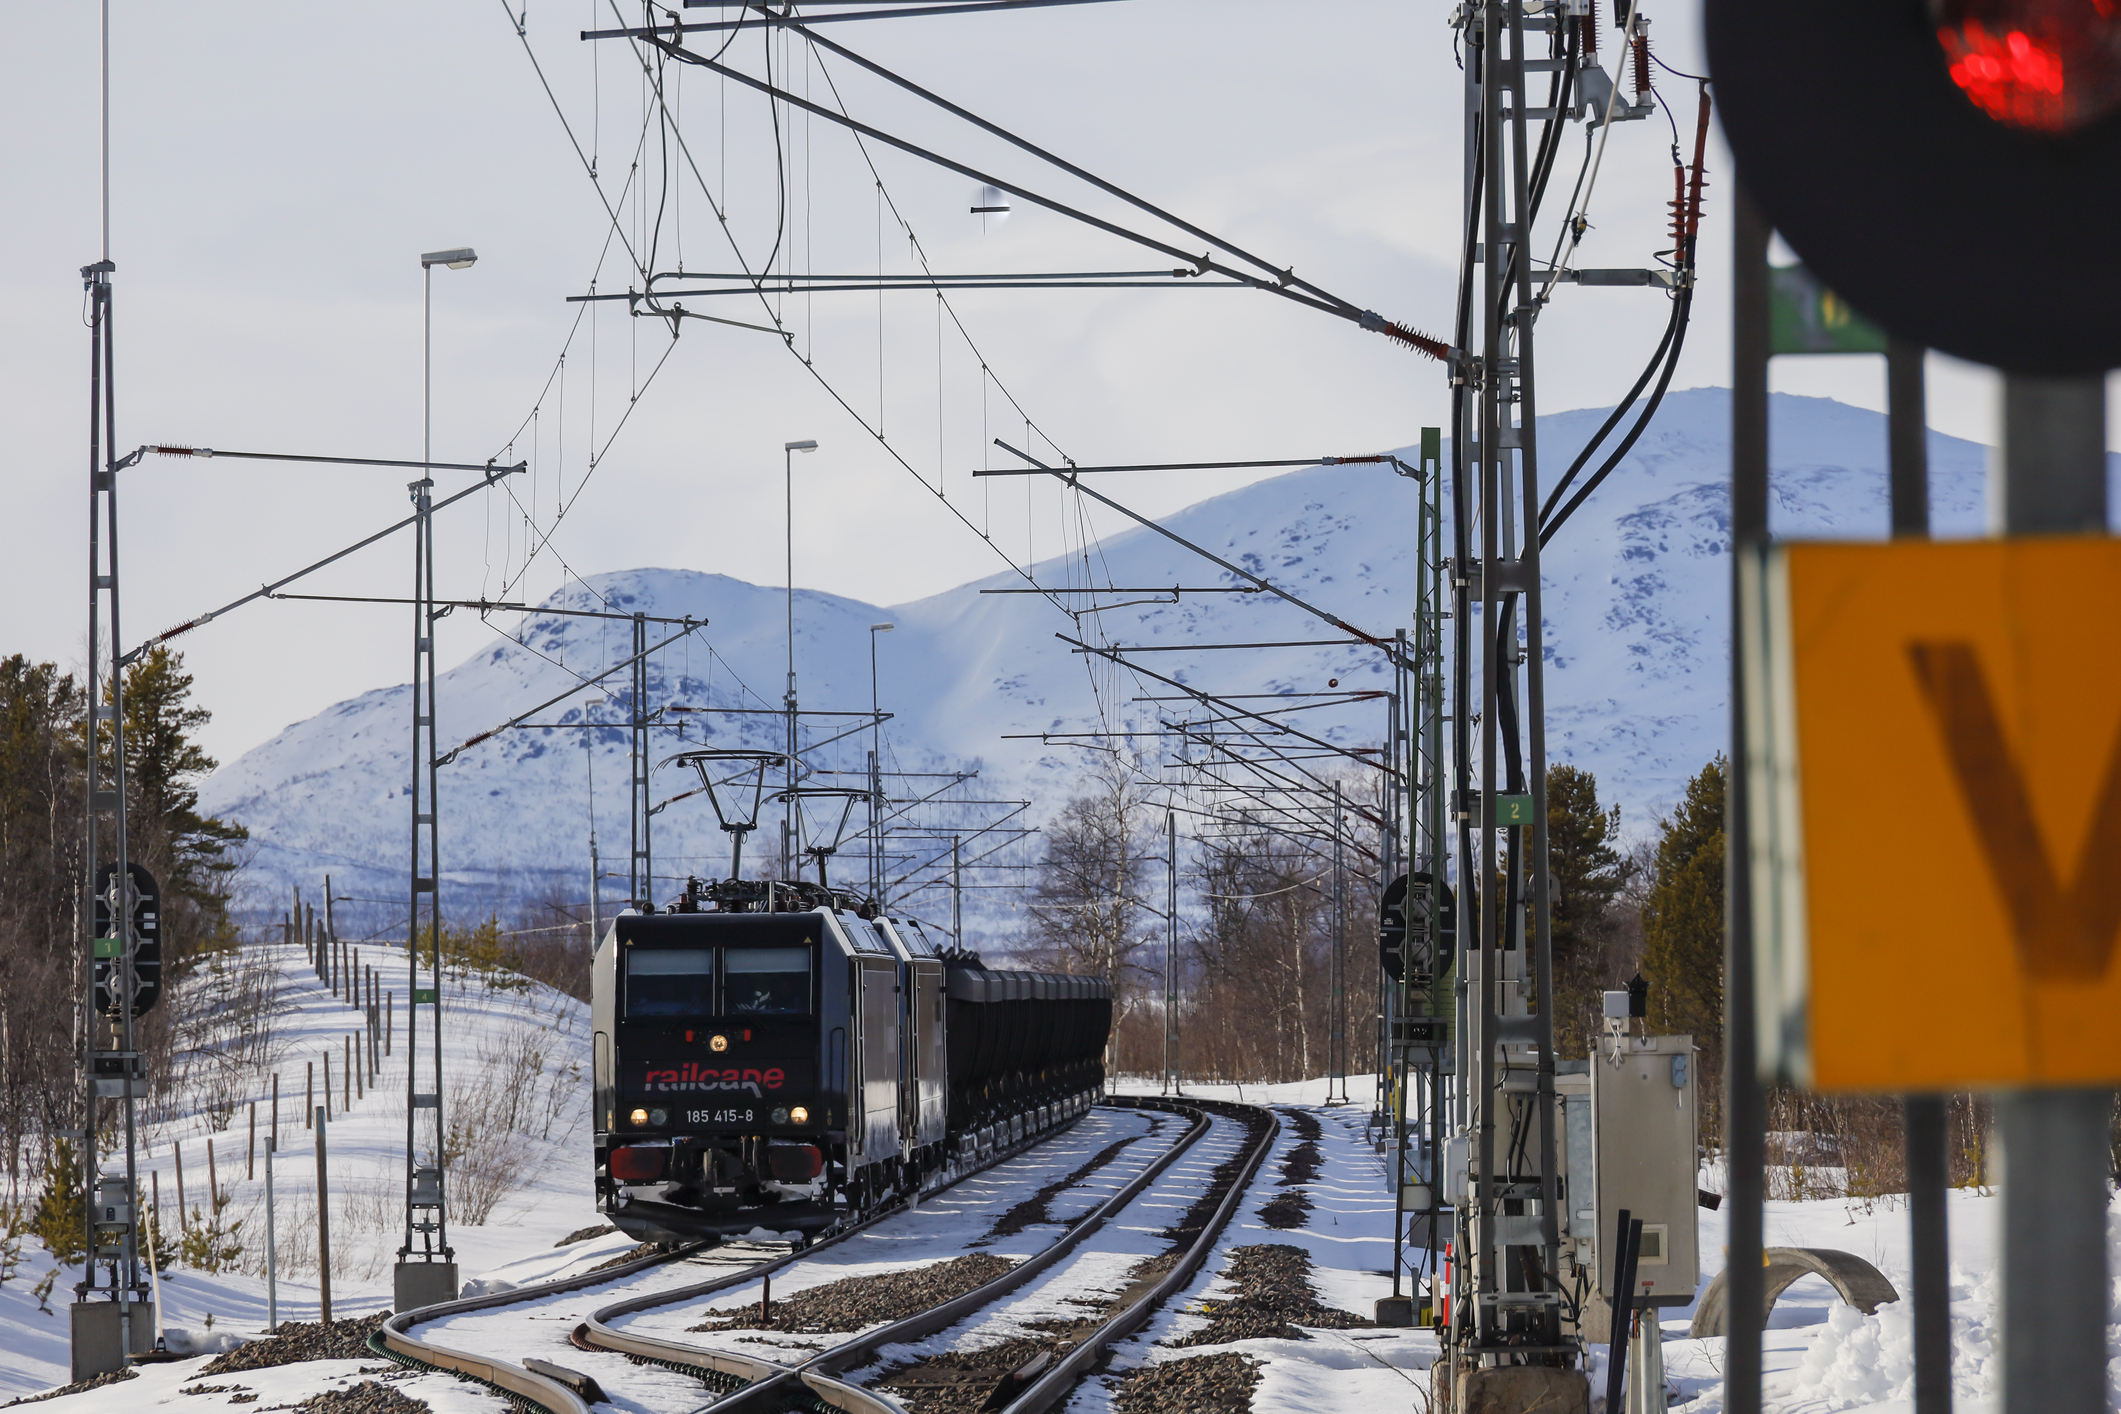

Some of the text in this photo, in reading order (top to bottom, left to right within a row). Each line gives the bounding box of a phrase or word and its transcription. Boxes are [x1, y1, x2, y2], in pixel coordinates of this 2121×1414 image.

[1511, 803, 1520, 819] 2
[686, 1109, 754, 1123] 185 415-8
